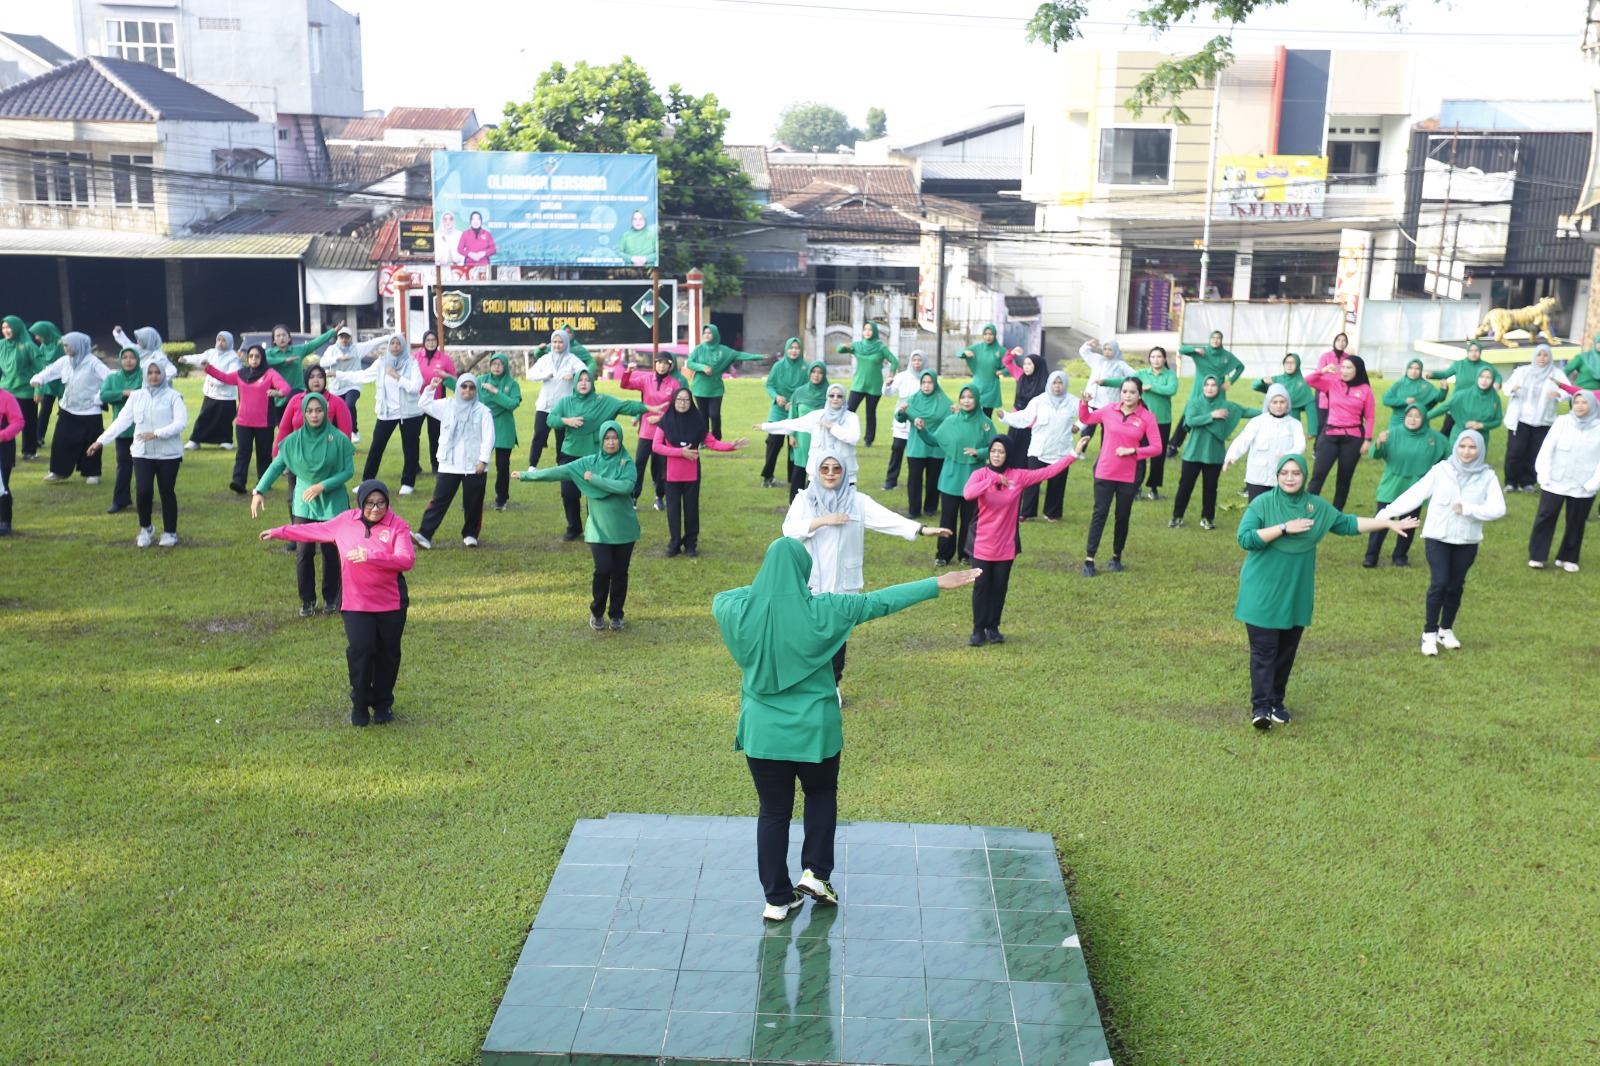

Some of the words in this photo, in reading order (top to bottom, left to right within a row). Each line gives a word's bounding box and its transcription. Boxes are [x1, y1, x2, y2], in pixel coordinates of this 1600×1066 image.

[482, 299, 506, 313] CADU
[508, 299, 543, 313] MUNDUR
[545, 299, 585, 313] PANTANG
[587, 299, 622, 313] MULANG
[510, 317, 530, 331] BILA
[533, 317, 550, 331] TAK
